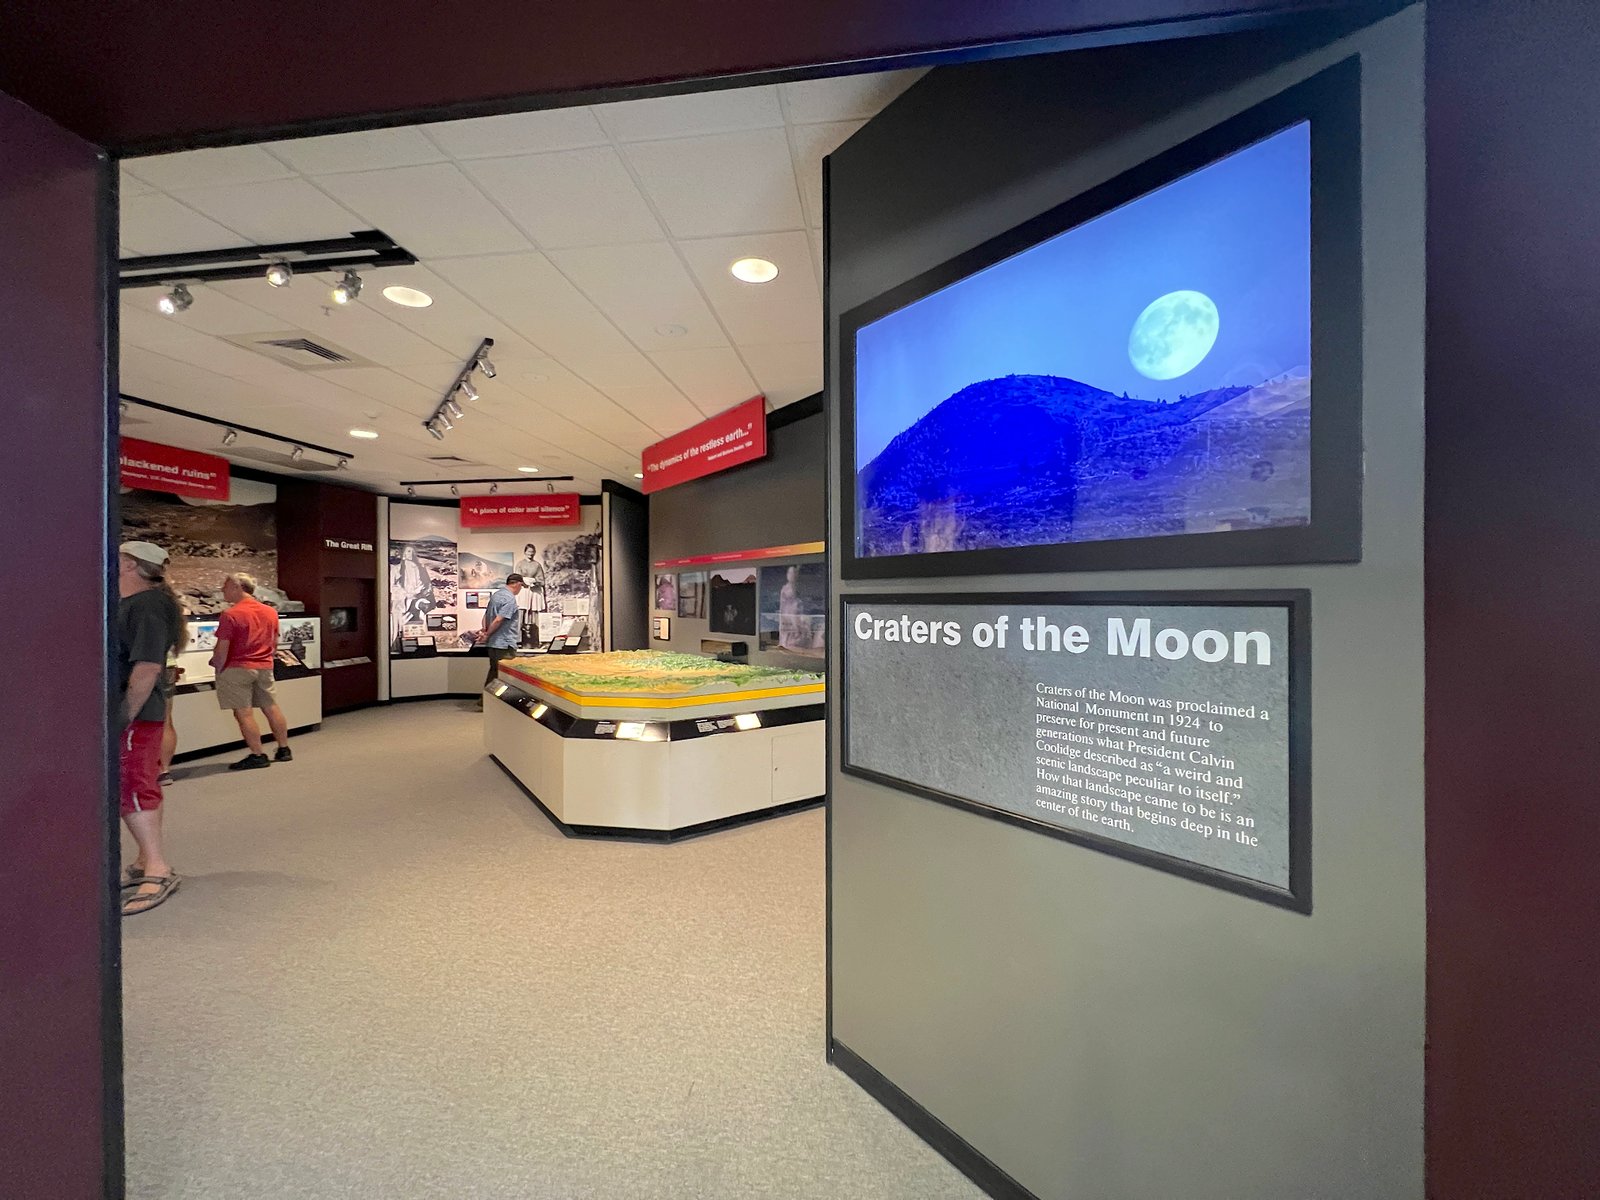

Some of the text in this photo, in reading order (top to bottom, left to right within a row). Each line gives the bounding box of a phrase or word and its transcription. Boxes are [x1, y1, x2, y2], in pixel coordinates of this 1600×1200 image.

[683, 449, 690, 460] of
[690, 446, 699, 457] the
[700, 436, 724, 454] restless
[325, 539, 339, 548] The
[340, 541, 360, 550] Great
[854, 612, 1271, 666] Craters of the Moon
[1036, 682, 1270, 721] Craters of the Moon was proclaimed a
[1036, 697, 1224, 733] National Monument in 1924 to
[1036, 713, 1210, 748] preserve for present and future
[1036, 727, 1235, 770] generations what President Calvin
[1036, 740, 1244, 789] Coolidge described as “a weird and
[1036, 755, 1241, 806] scenic landscape peculiar to itself.”
[1036, 767, 1255, 828] How that landscape came to be is an
[1036, 784, 1258, 847] amazing story that begins deep in the
[1036, 798, 1134, 833] center of the earth.
